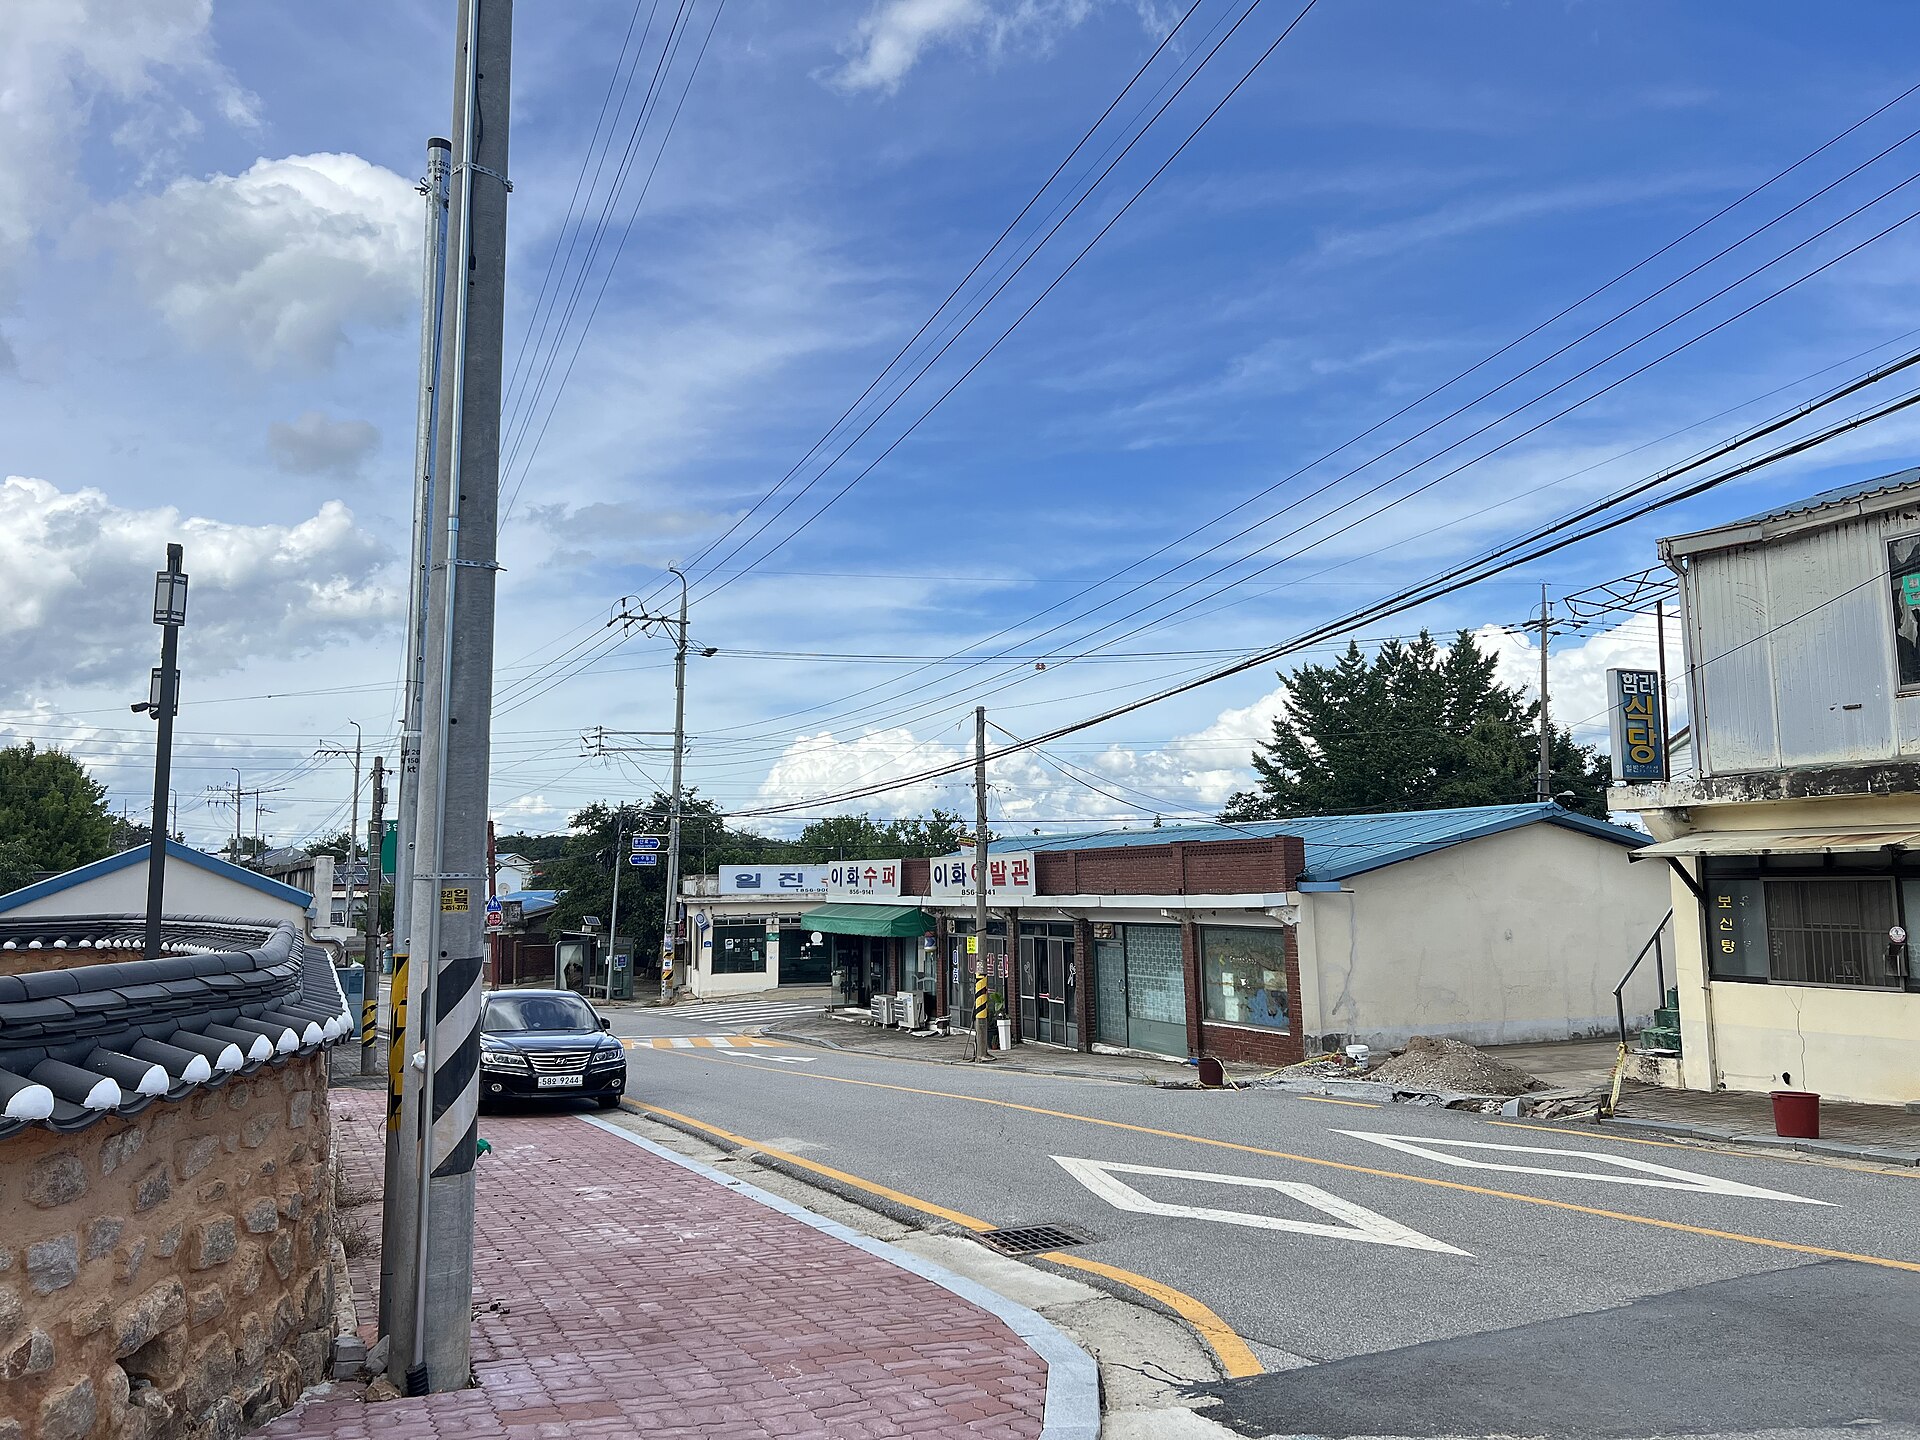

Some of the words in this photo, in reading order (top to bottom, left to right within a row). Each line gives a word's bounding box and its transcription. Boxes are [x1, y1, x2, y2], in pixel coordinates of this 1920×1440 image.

[1622, 673, 1655, 695] 함라
[1625, 696, 1657, 763] 식당
[407, 765, 417, 773] kt
[831, 866, 896, 888] 이화수퍼
[1717, 895, 1736, 954] 보신탕
[559, 1076, 579, 1085] 9244
